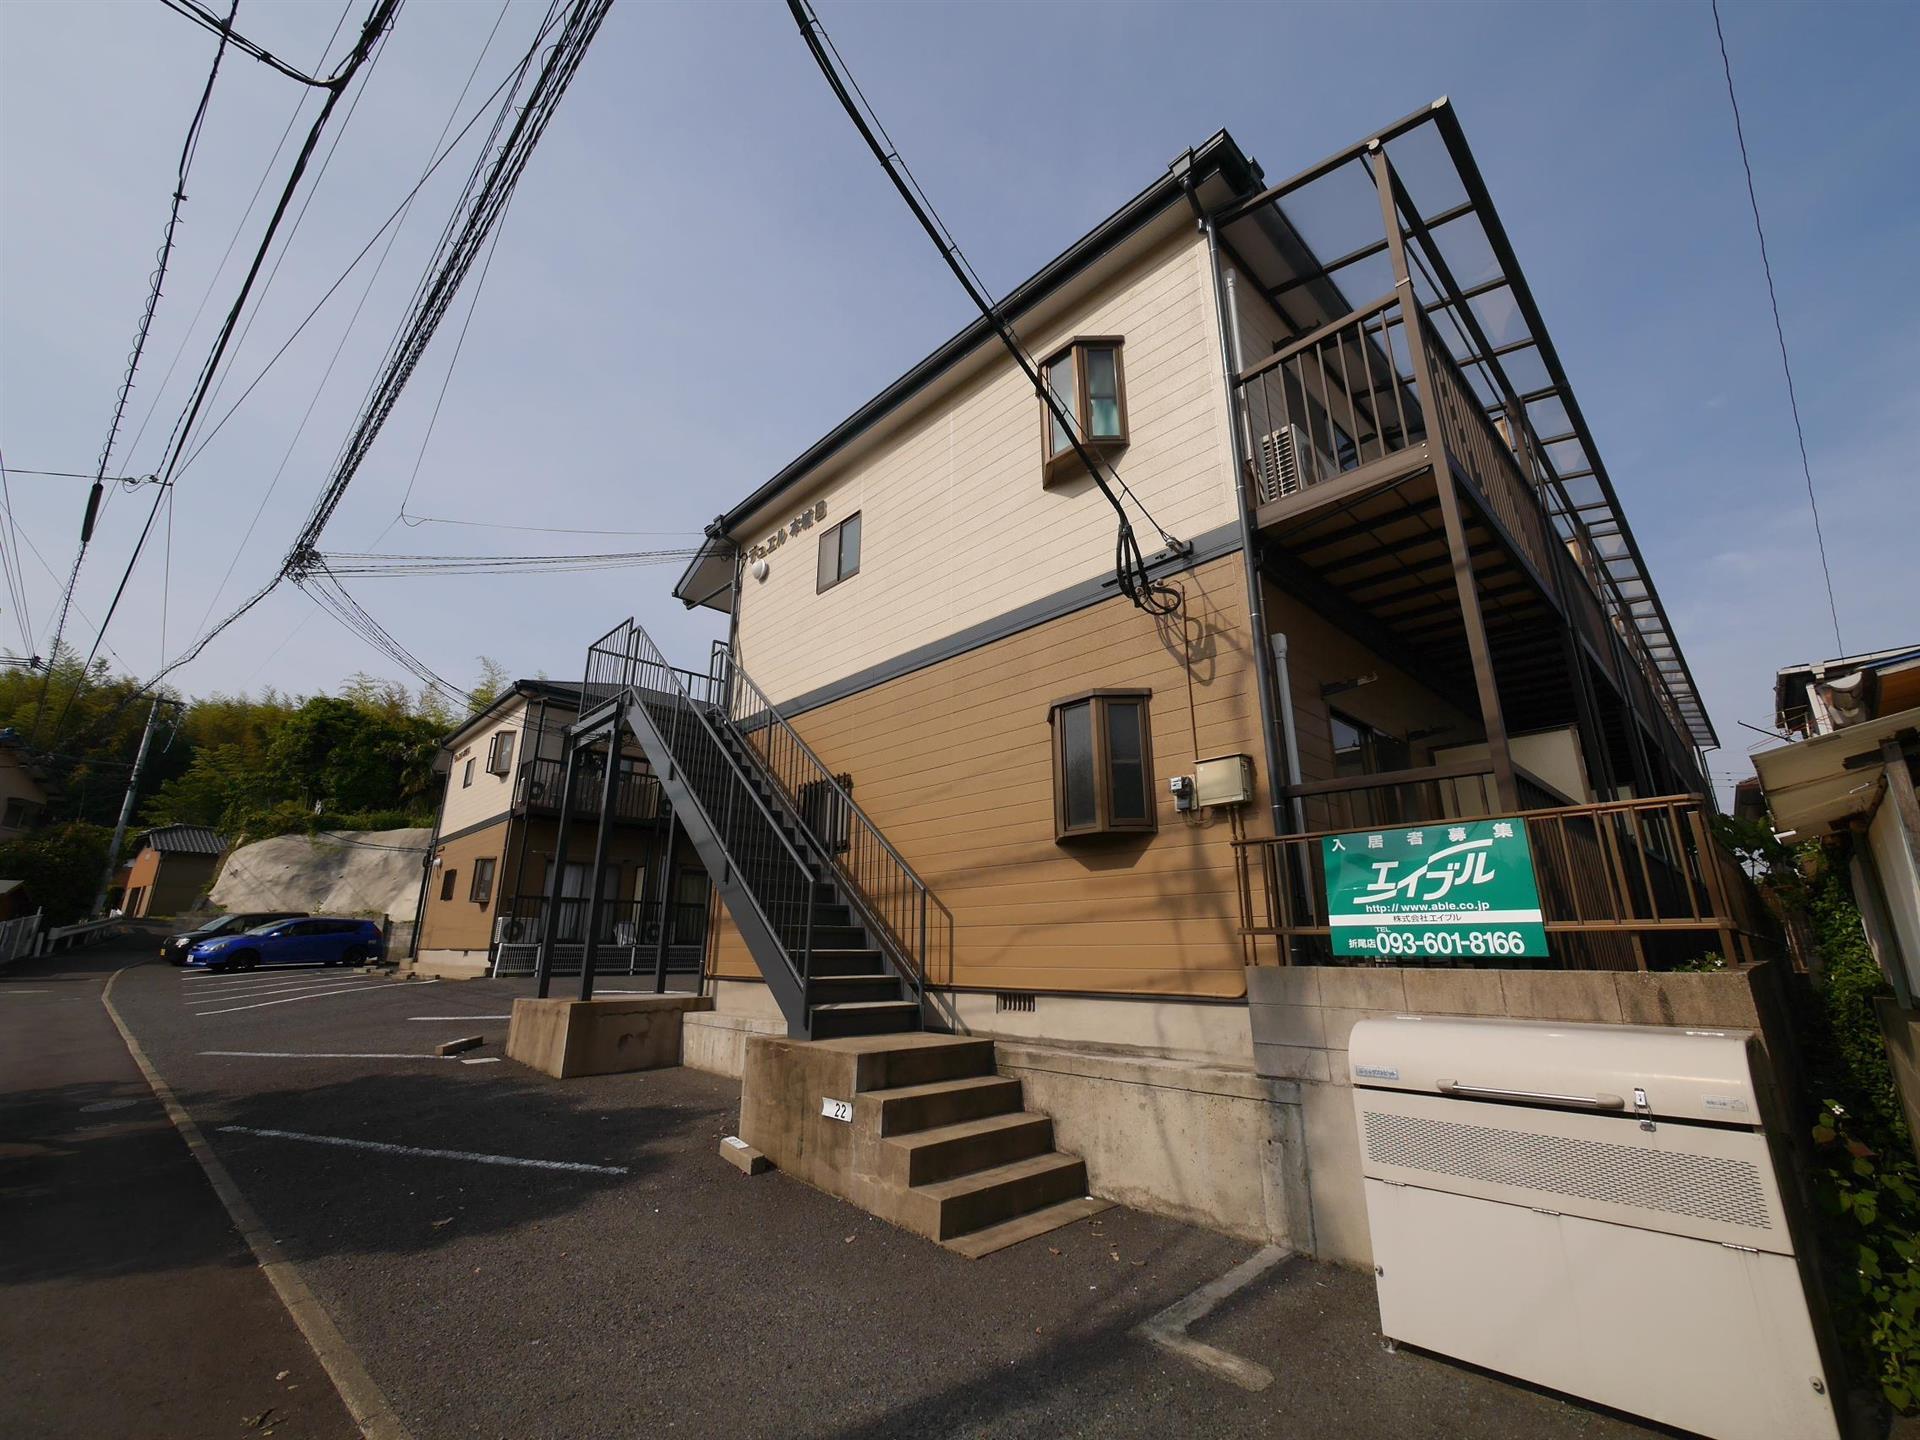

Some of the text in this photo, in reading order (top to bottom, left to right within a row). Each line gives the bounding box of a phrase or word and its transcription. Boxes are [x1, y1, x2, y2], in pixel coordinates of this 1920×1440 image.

[1332, 822, 1514, 852] 入居者募集
[1353, 838, 1495, 904] エイブル
[1393, 913, 1462, 923] 株式会社エイブル
[1348, 931, 1525, 954] 折尾店 093-601-8166
[834, 1102, 847, 1119] 22
